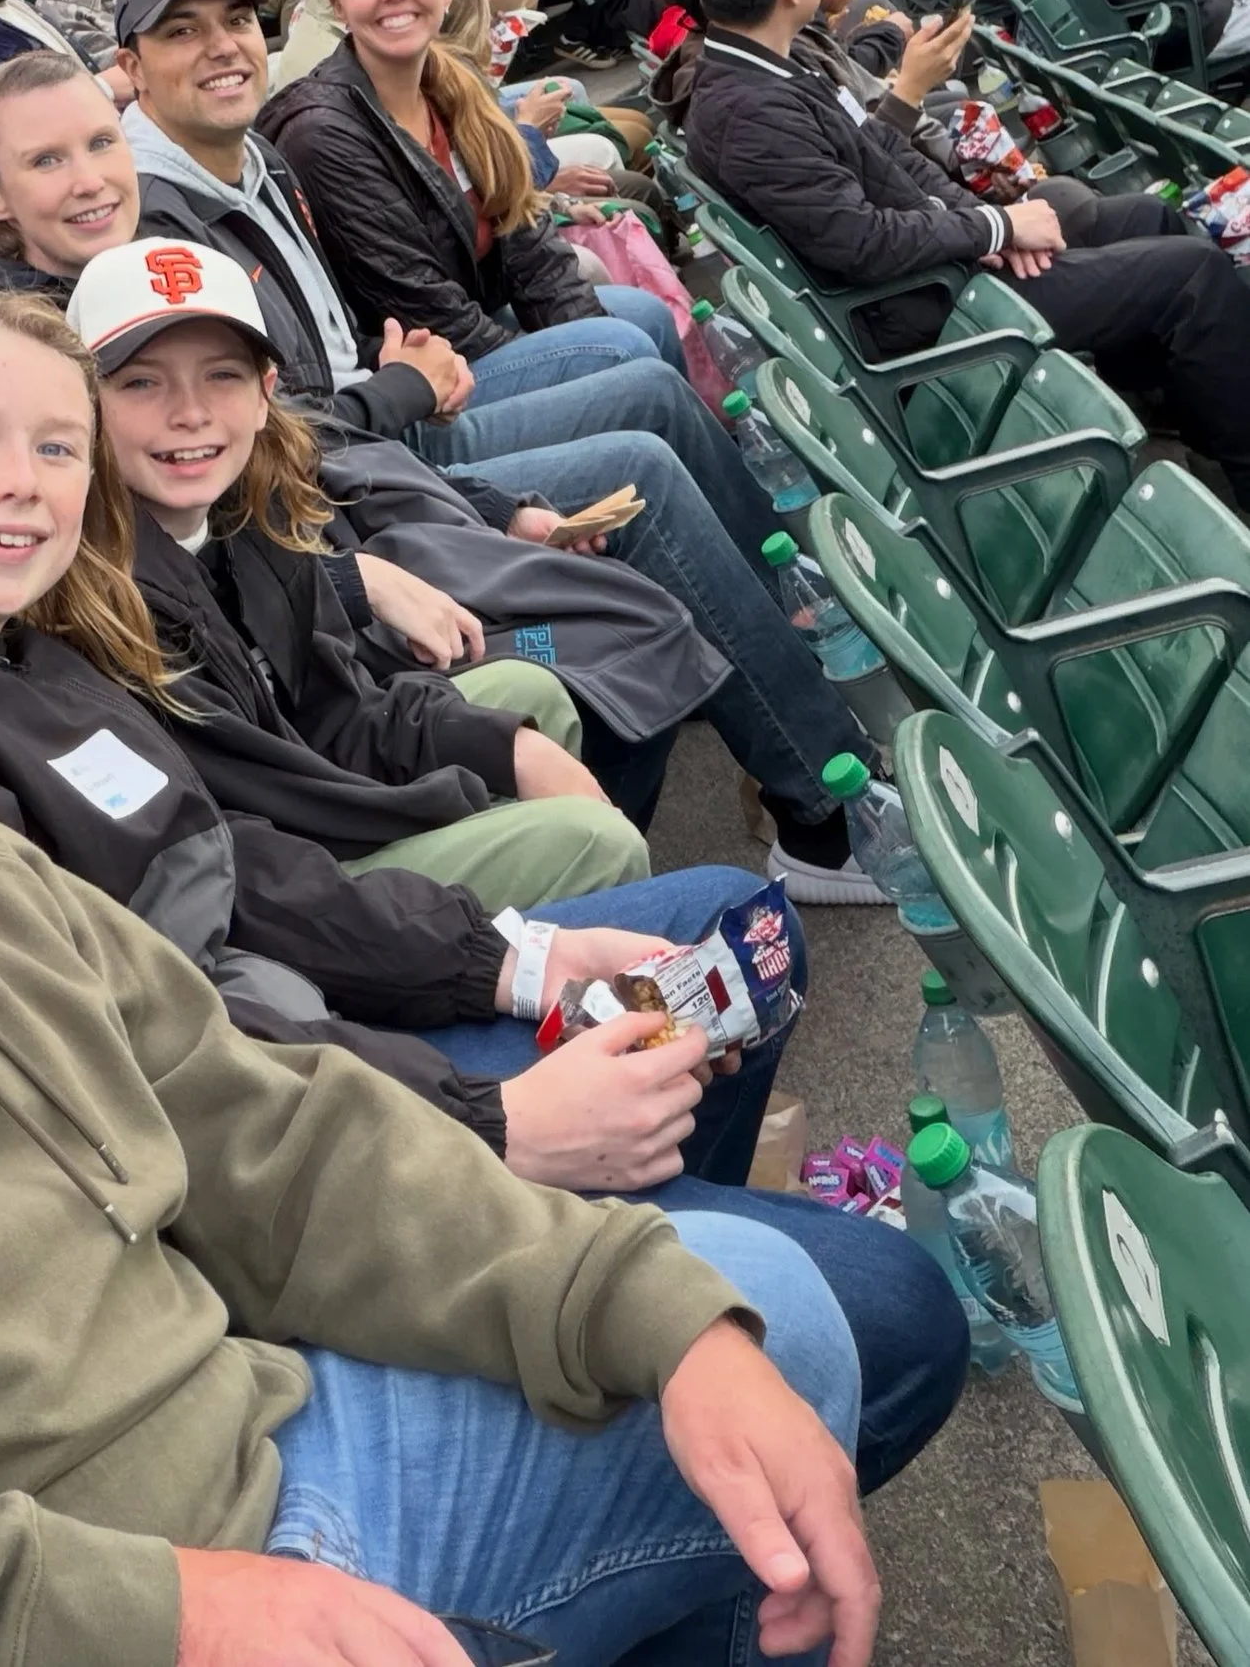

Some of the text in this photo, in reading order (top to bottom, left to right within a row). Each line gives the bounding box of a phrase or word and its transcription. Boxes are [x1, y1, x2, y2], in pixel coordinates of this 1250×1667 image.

[145, 246, 203, 304] SF
[676, 970, 701, 990] Facts
[692, 992, 710, 1010] 120
